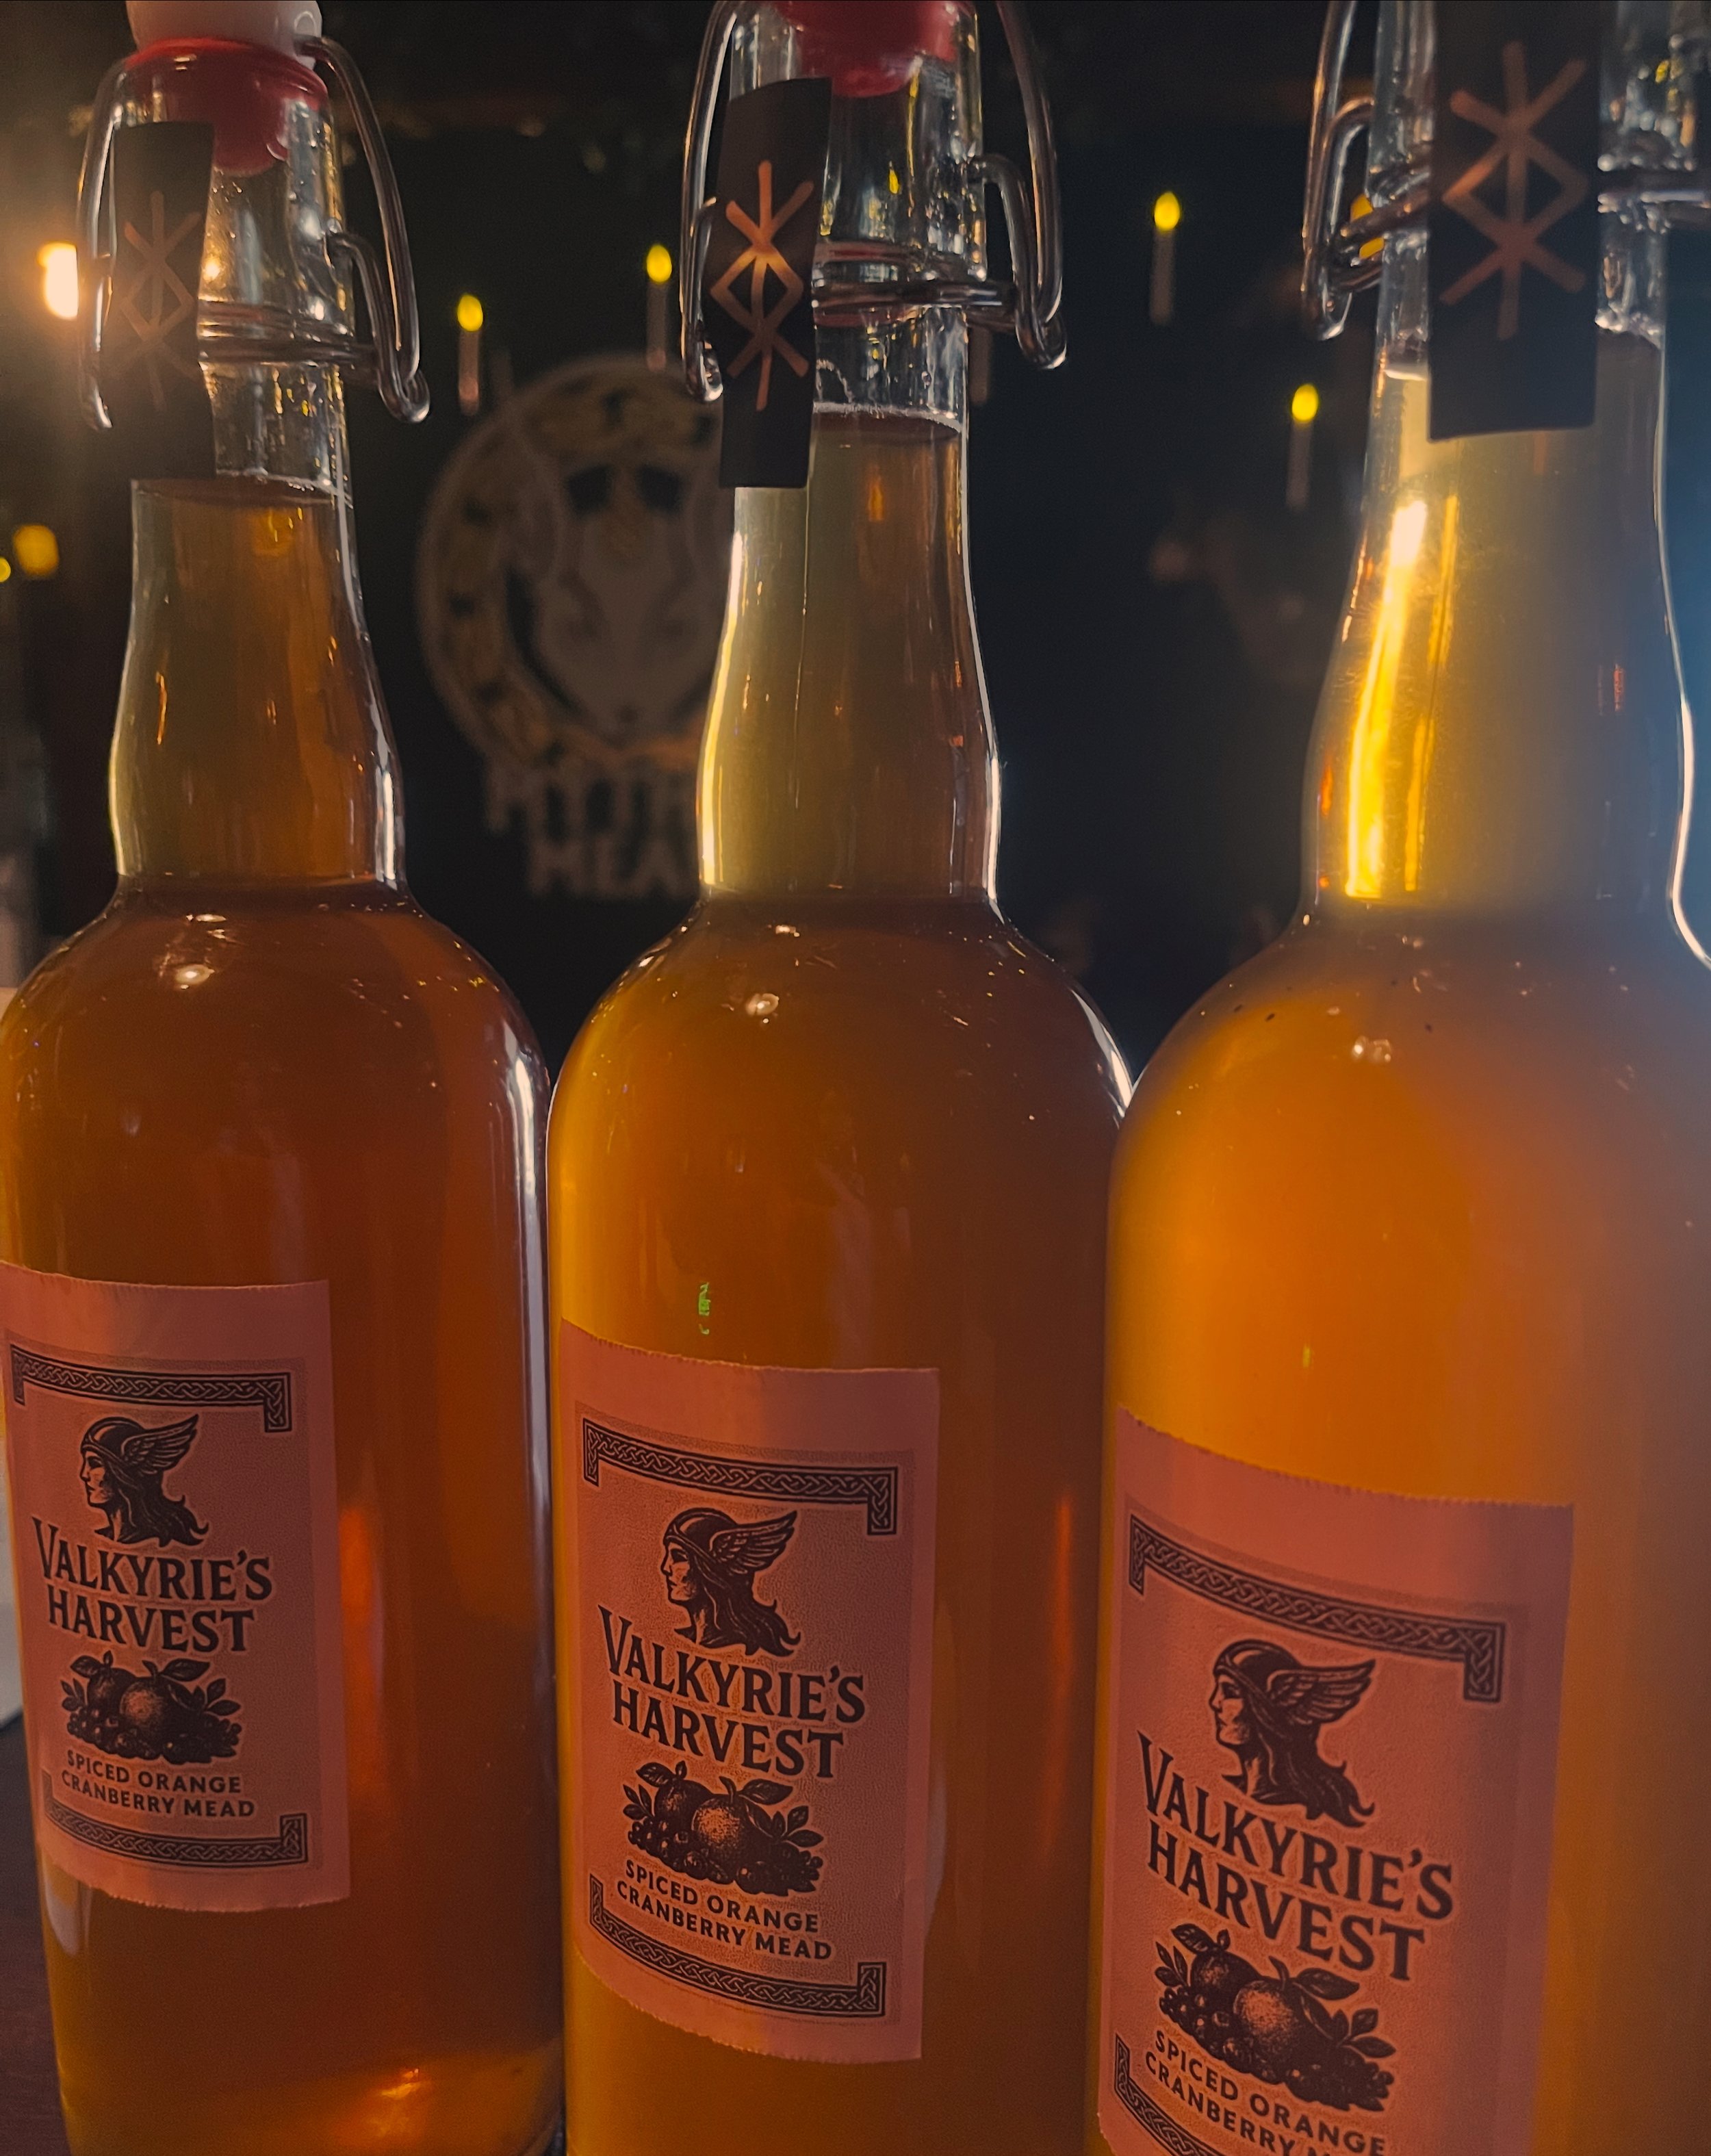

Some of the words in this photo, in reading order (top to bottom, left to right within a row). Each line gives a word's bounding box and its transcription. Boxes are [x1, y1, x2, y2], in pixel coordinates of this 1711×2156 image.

[31, 1516, 273, 1601] VALKYRIE'S
[47, 1584, 255, 1652] HARVEST
[597, 1604, 865, 1723] VALKYRIE'S
[67, 1749, 130, 1783] SPICED
[138, 1771, 242, 1793] ORANGE
[613, 1680, 843, 1778] HARVEST
[61, 1770, 175, 1814] CRANBERRY
[183, 1799, 255, 1818] MEAD
[1137, 1730, 1454, 1920] VALKYRIE'S
[617, 1880, 747, 1946] CRANBERRY
[755, 1932, 832, 1960] MEAD
[626, 1860, 698, 1905] SPICED
[706, 1895, 819, 1933] ORANGE
[1147, 1819, 1425, 1980] HARVEST
[1145, 2051, 1297, 2156] CRANBERRY
[1155, 2030, 1239, 2101] SPICED
[1249, 2093, 1386, 2155] ORANGE
